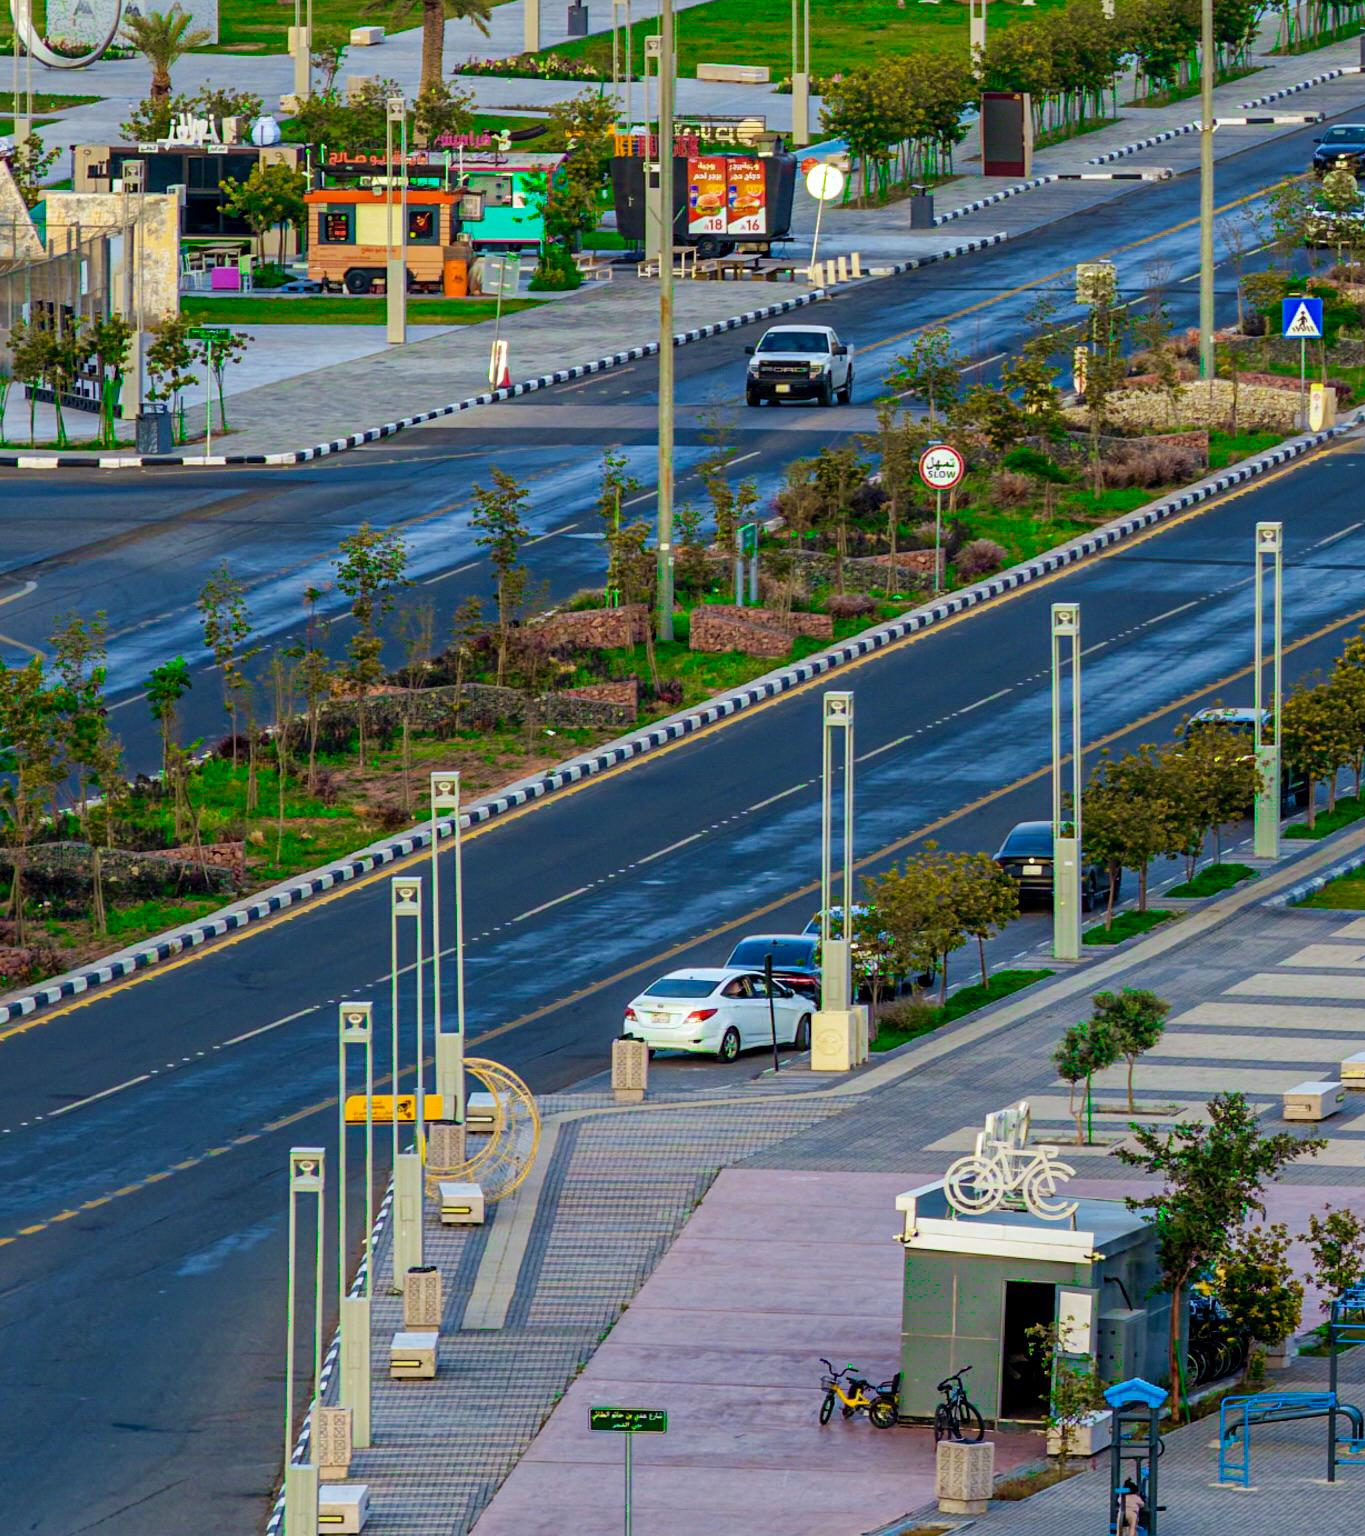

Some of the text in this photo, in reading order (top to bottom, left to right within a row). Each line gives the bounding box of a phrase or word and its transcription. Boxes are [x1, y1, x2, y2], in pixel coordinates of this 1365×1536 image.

[708, 219, 723, 231] 18
[746, 219, 760, 231] 16
[926, 457, 955, 471] تمهل
[927, 470, 956, 479] SLOW
[611, 1411, 624, 1419] حاتم
[649, 1412, 663, 1421] شارع
